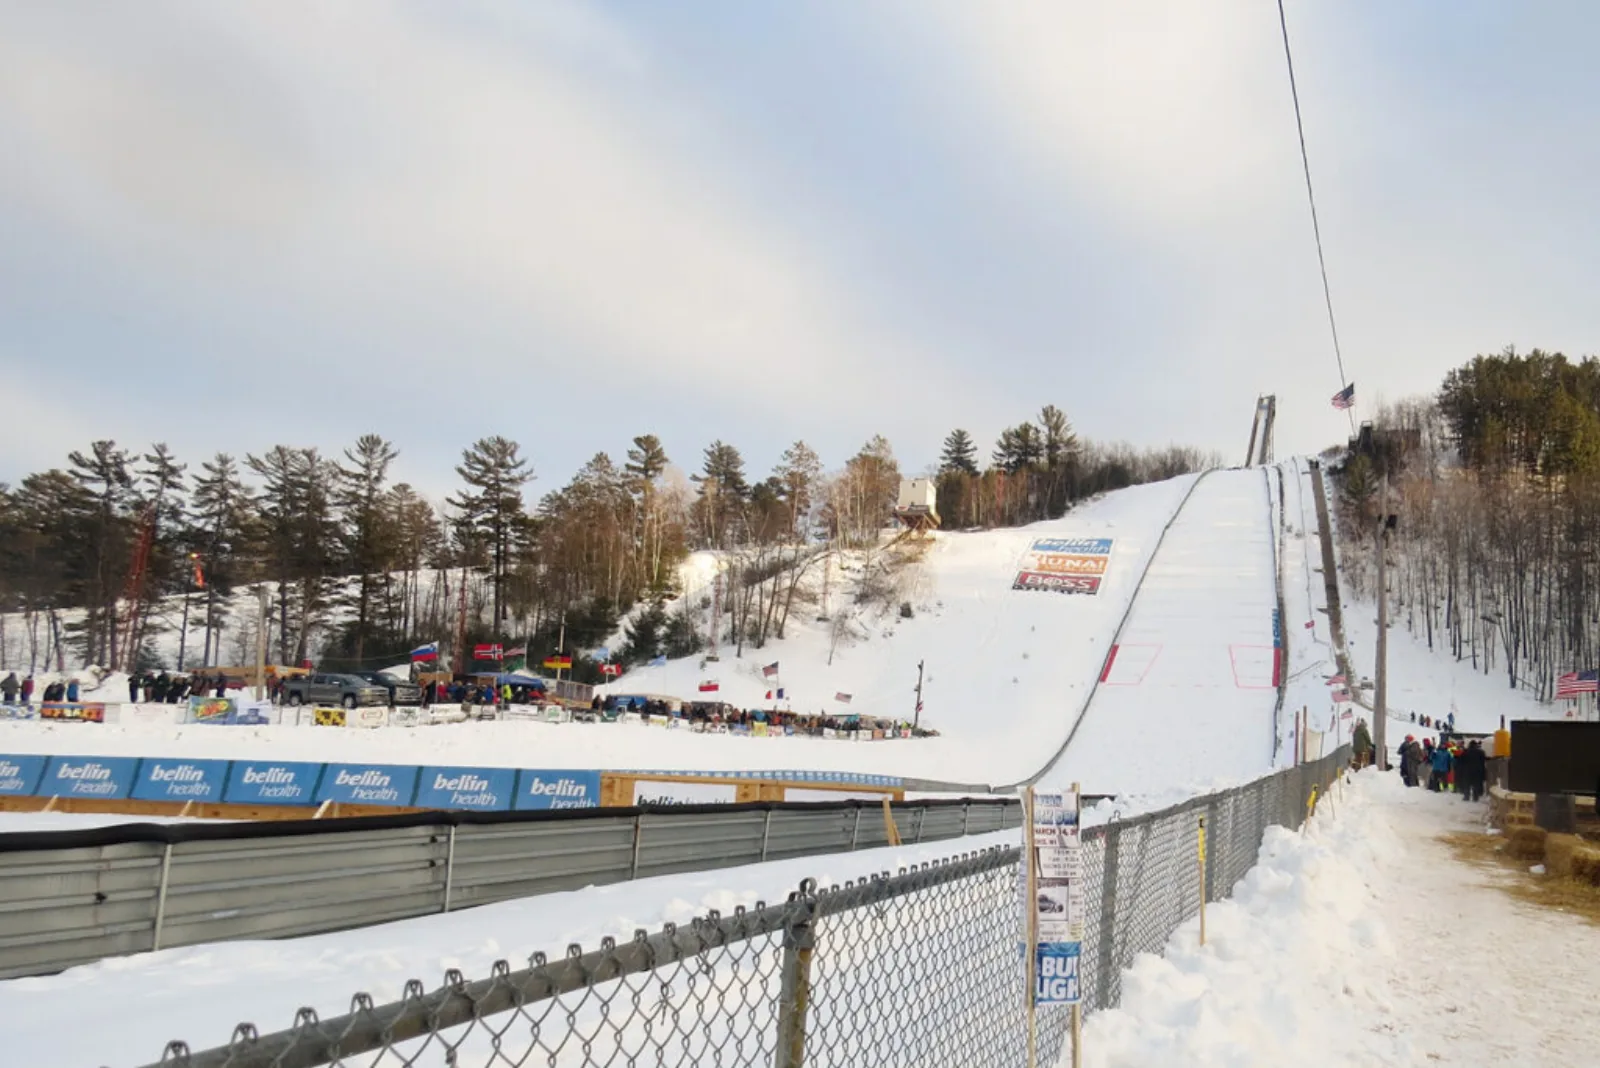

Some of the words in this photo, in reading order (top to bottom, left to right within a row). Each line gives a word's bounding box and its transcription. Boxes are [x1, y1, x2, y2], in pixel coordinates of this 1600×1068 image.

[57, 763, 111, 780] bellin
[151, 764, 204, 781] bellin
[243, 767, 295, 784] bellin
[335, 770, 390, 787] bellin
[71, 780, 118, 795] health
[166, 780, 210, 796] health
[258, 783, 302, 798] health
[433, 774, 488, 791] bellin
[530, 778, 586, 797] bellin
[351, 786, 398, 801] health
[450, 790, 498, 807] health
